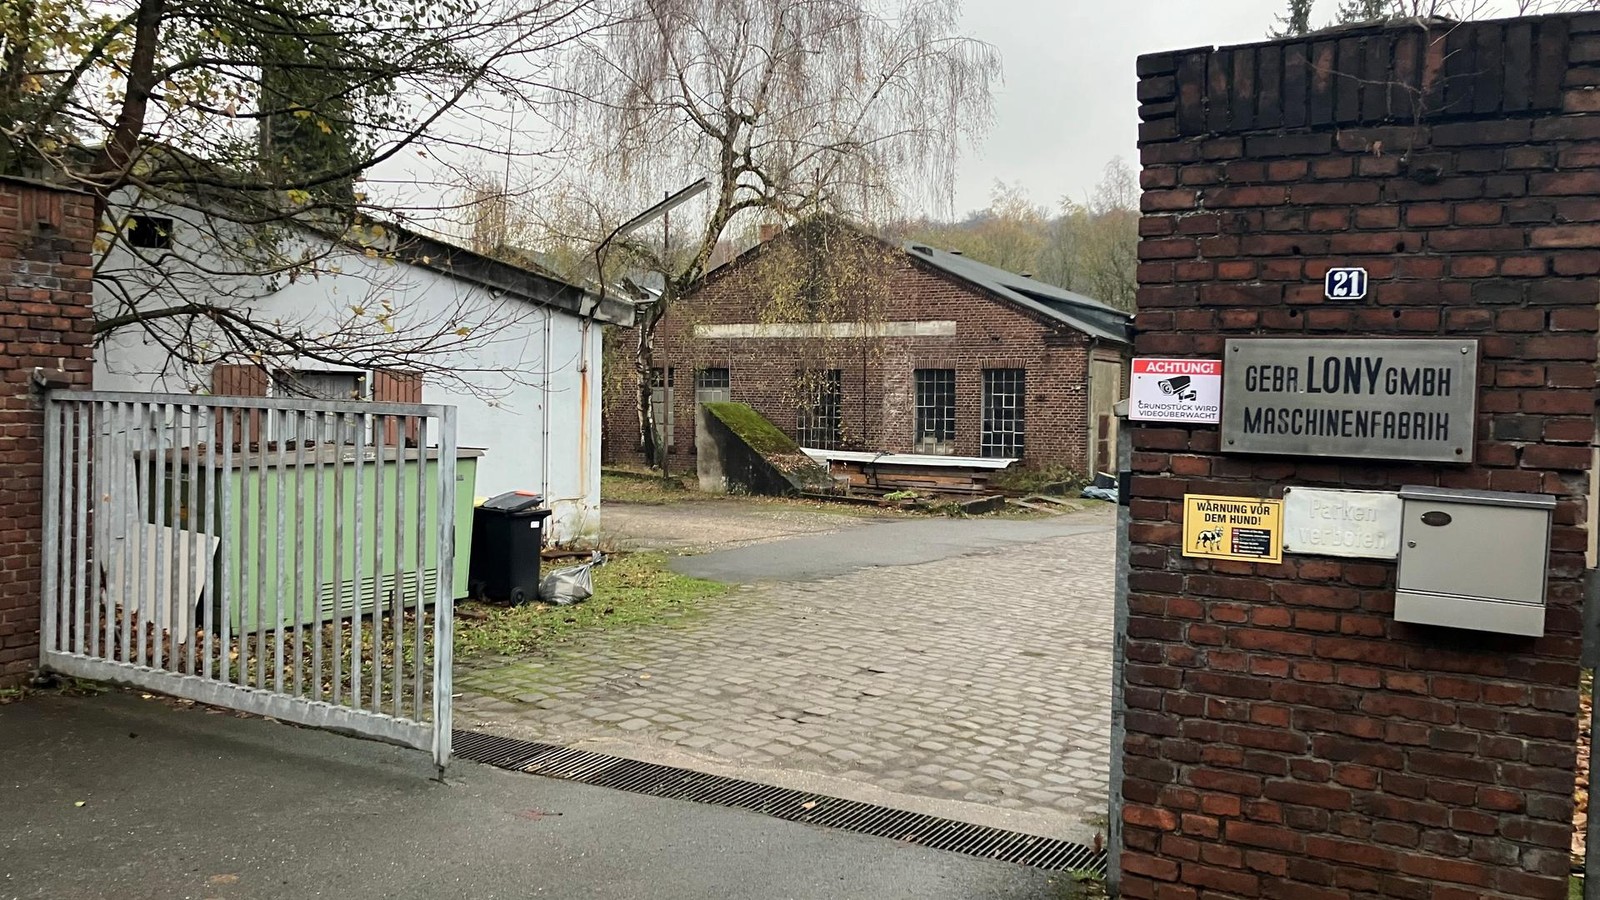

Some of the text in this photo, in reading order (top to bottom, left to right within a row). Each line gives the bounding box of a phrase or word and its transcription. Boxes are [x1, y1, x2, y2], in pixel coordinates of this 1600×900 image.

[1333, 271, 1360, 297] 21
[1146, 361, 1214, 374] ACHTUNG!
[1306, 356, 1383, 395] LONY
[1385, 367, 1451, 396] GMBH
[1138, 402, 1193, 411] GRUNDSTÜCK
[1138, 409, 1217, 419] VIDEOÜBERWACHT
[1243, 406, 1449, 441] MASCHINENFABRIK
[1197, 502, 1270, 515] WARNUNG VOR
[1309, 499, 1377, 522] Parken
[1204, 513, 1261, 526] DEM HUND!
[1299, 526, 1386, 549] verboten
